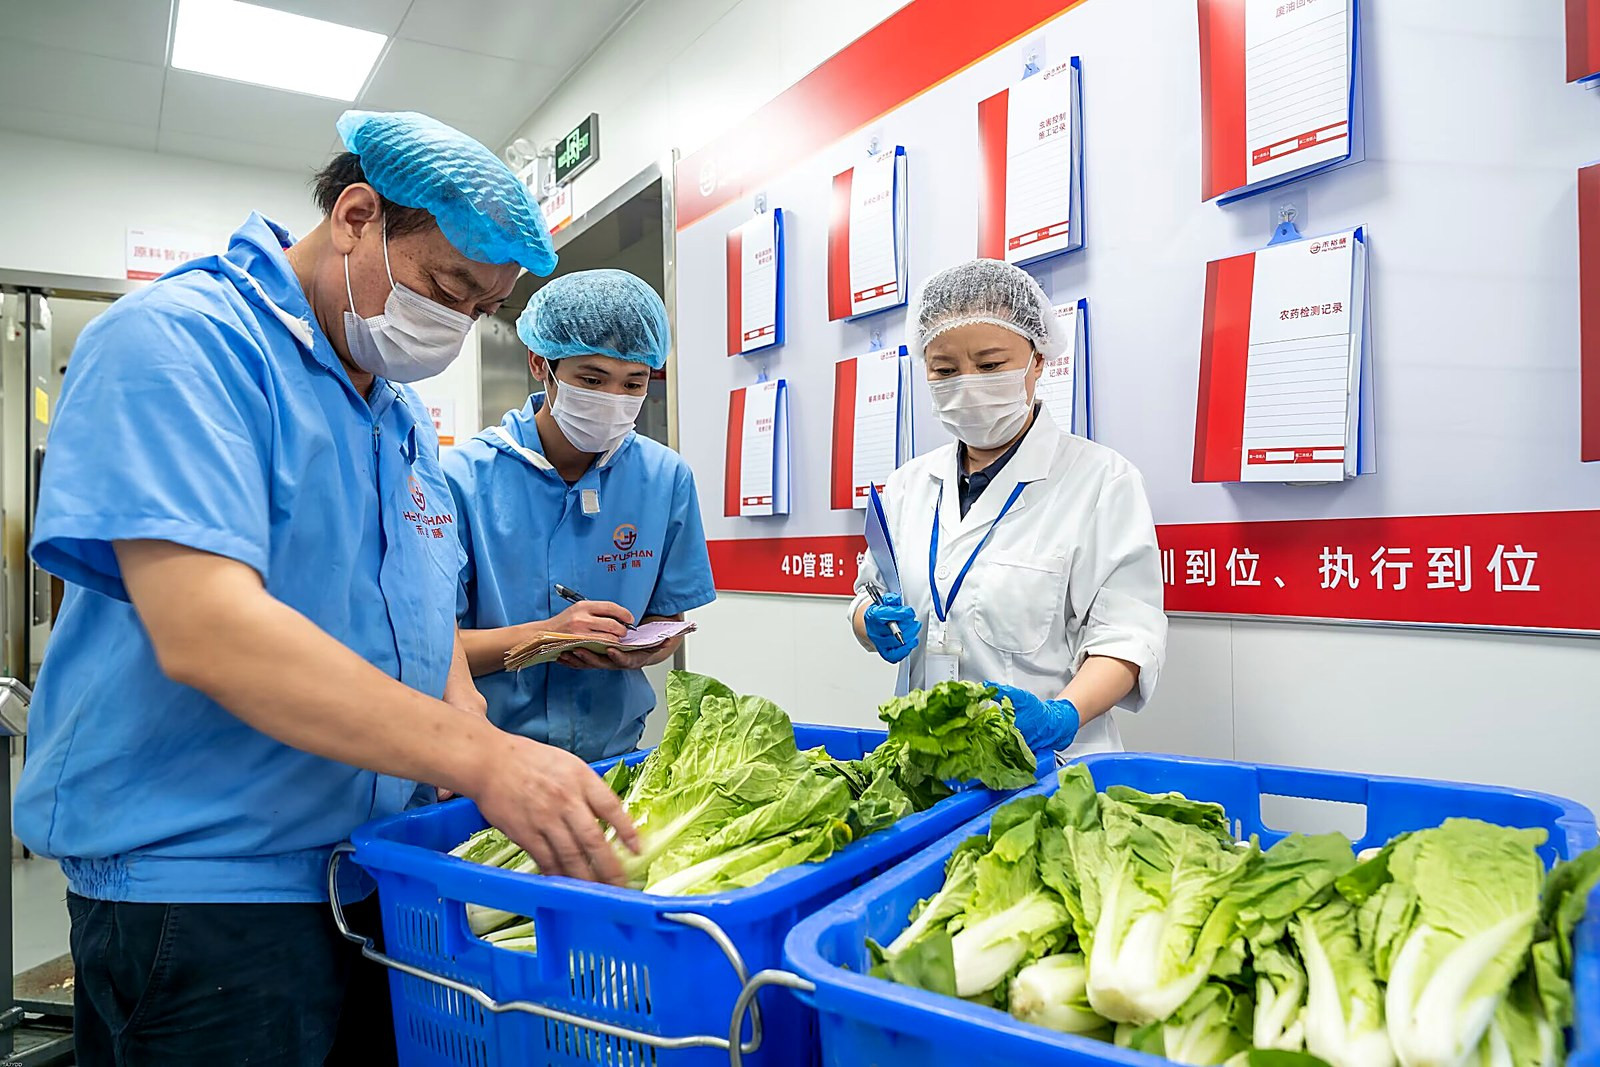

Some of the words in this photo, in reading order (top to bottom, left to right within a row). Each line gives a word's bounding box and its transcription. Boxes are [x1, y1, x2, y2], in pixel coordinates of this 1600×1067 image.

[1280, 301, 1343, 320] 农药检测记录
